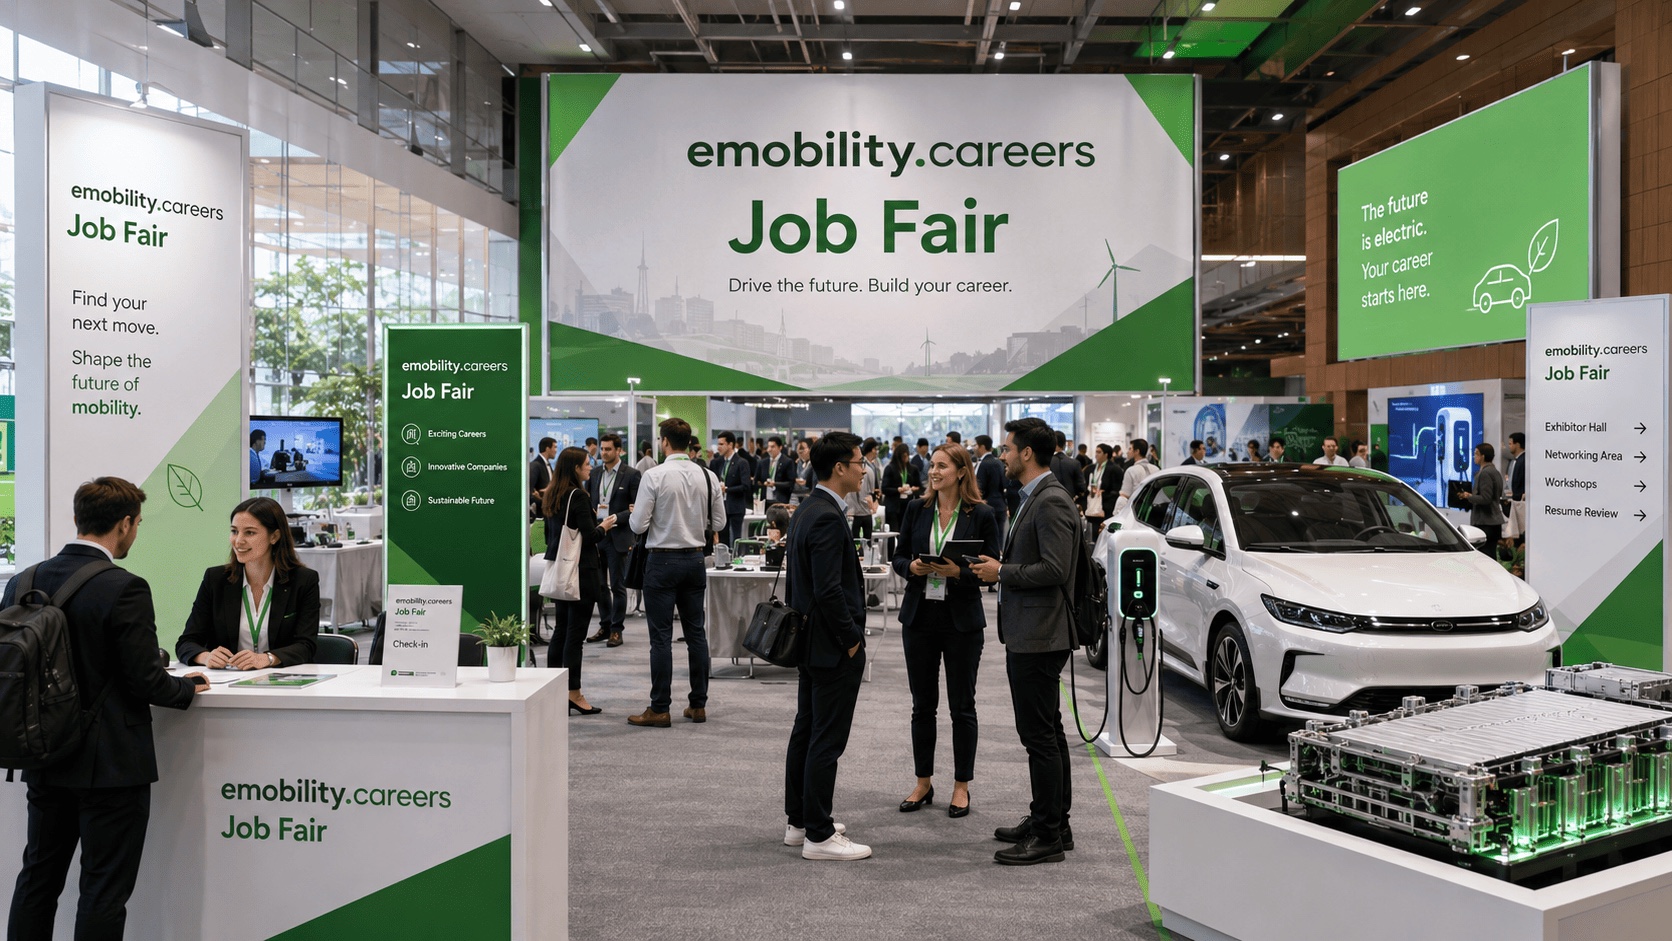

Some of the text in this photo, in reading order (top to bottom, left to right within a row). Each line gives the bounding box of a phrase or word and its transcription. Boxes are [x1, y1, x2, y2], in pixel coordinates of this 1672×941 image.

[688, 131, 1095, 177] emobility.careers
[71, 185, 223, 220] emobility.careers
[1362, 191, 1428, 221] The future
[67, 214, 168, 247] Job Fair
[728, 197, 1008, 254] Job Fair
[1362, 220, 1426, 250] is electric.
[1362, 252, 1433, 279] Your career
[730, 278, 1012, 296] Drive the future. Build your career.
[1362, 284, 1430, 307] starts here.
[73, 290, 147, 312] Find your
[73, 318, 158, 335] next move.
[72, 350, 151, 369] Shape the
[1545, 345, 1647, 358] emobility.careers
[402, 360, 508, 374] emobility.careers
[1545, 365, 1610, 380] Job Fair
[72, 374, 139, 391] future of
[402, 383, 474, 399] Job Fair
[73, 399, 141, 419] mobility.
[428, 430, 456, 439] Exciting
[1546, 422, 1606, 432] Exhibitor Hall
[1545, 450, 1622, 462] Networking Area
[467, 463, 507, 472] Companies
[1545, 478, 1597, 490] Workshops
[1545, 505, 1618, 518] Resume Review
[393, 640, 428, 648] Check-in
[221, 779, 451, 810] emobility.careers
[221, 815, 327, 842] Job Fair
